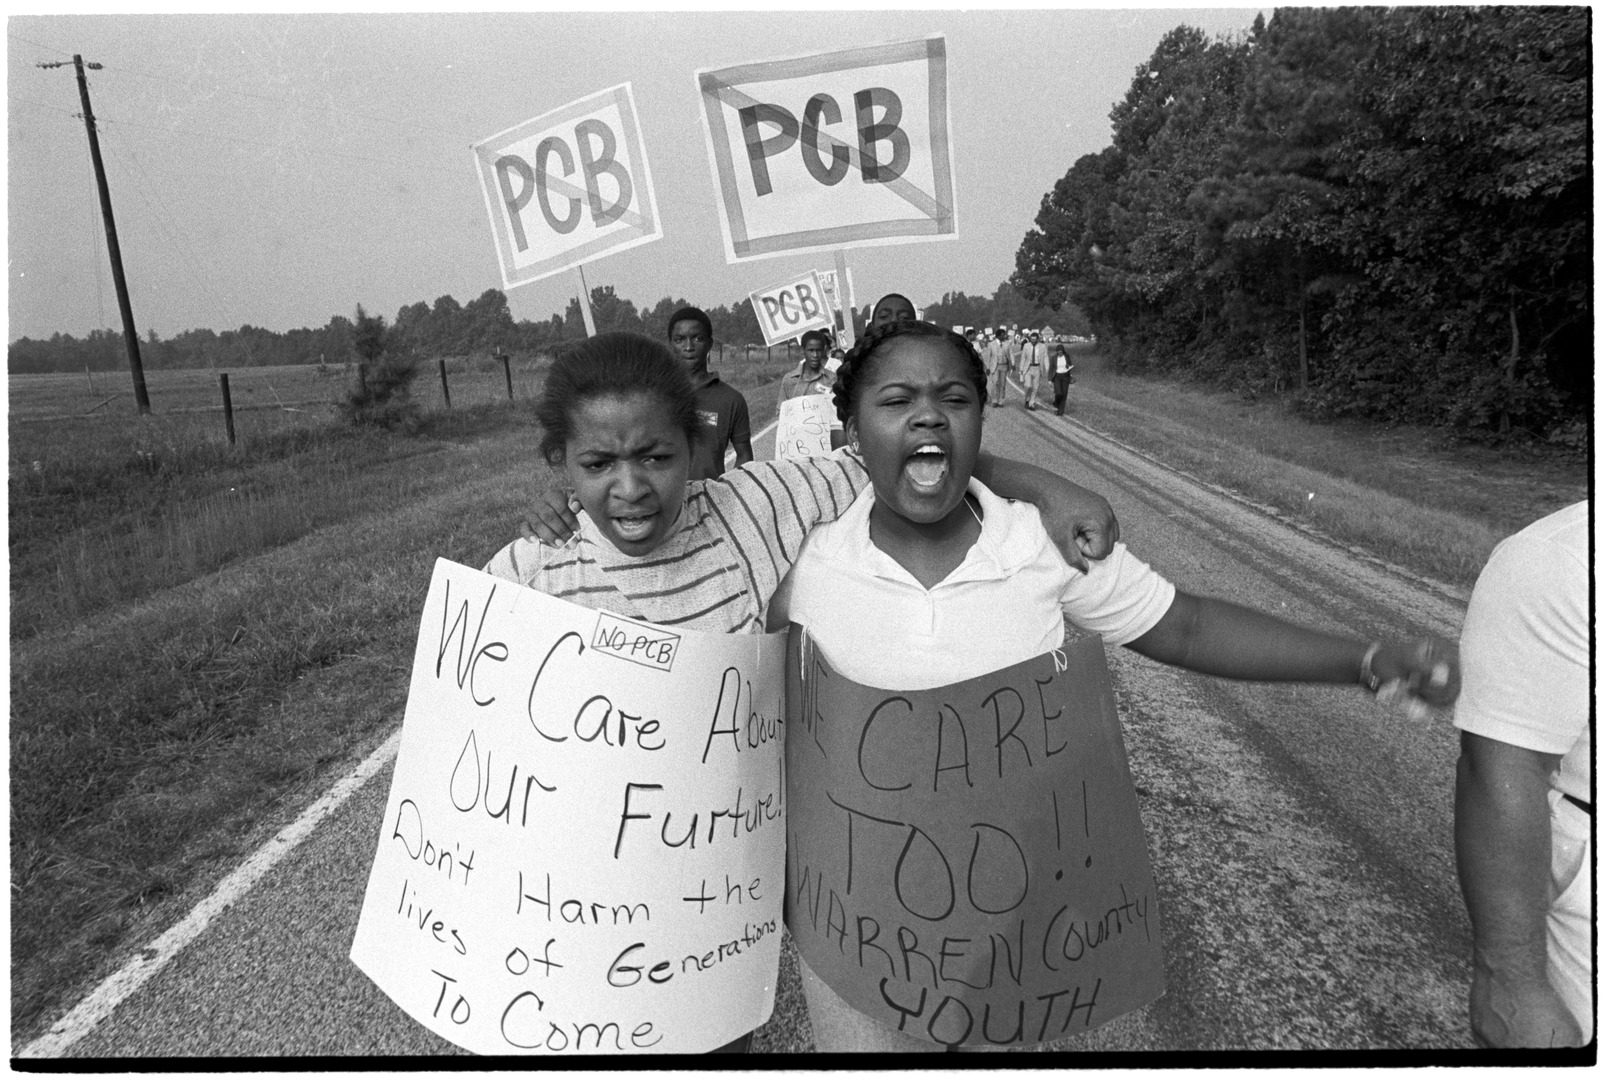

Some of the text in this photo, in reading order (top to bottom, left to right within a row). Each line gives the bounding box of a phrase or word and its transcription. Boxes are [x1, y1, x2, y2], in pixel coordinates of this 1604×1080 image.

[495, 119, 633, 253] PCB
[738, 87, 911, 197] PCB
[761, 283, 820, 332] PCB
[779, 439, 811, 460] PCB
[436, 579, 784, 764] We Care About
[598, 626, 673, 664] NO PCB
[796, 645, 1068, 792] WE CARE
[393, 798, 762, 925] Don't Harm the
[614, 757, 782, 859] Furture!
[398, 879, 777, 988] lives of Generations
[794, 831, 1025, 990] WARREN
[500, 991, 664, 1051] Come
[879, 977, 1102, 1046] YOUTH
